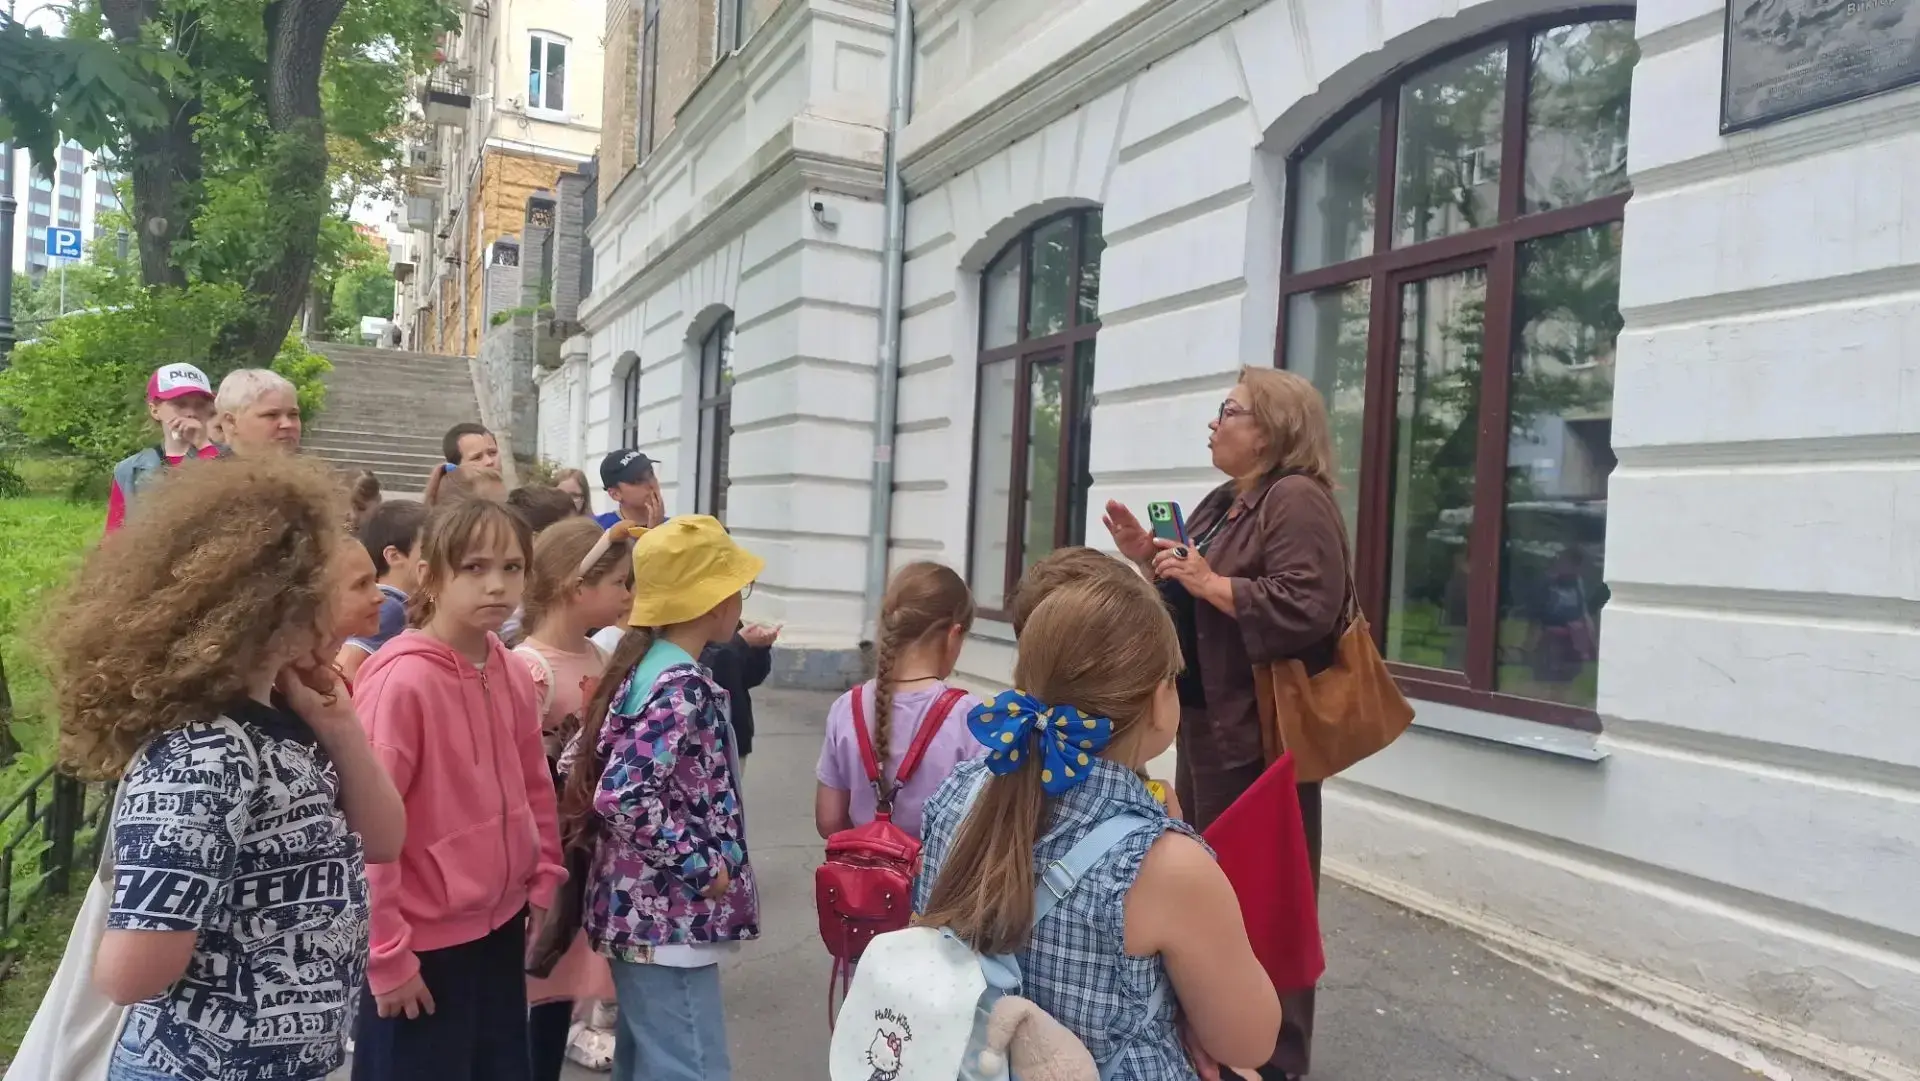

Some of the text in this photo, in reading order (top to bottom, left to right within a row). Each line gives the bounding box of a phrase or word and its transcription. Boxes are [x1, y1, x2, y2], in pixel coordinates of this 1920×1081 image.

[56, 230, 75, 254] P
[874, 1007, 912, 1042] Hello Kitty
